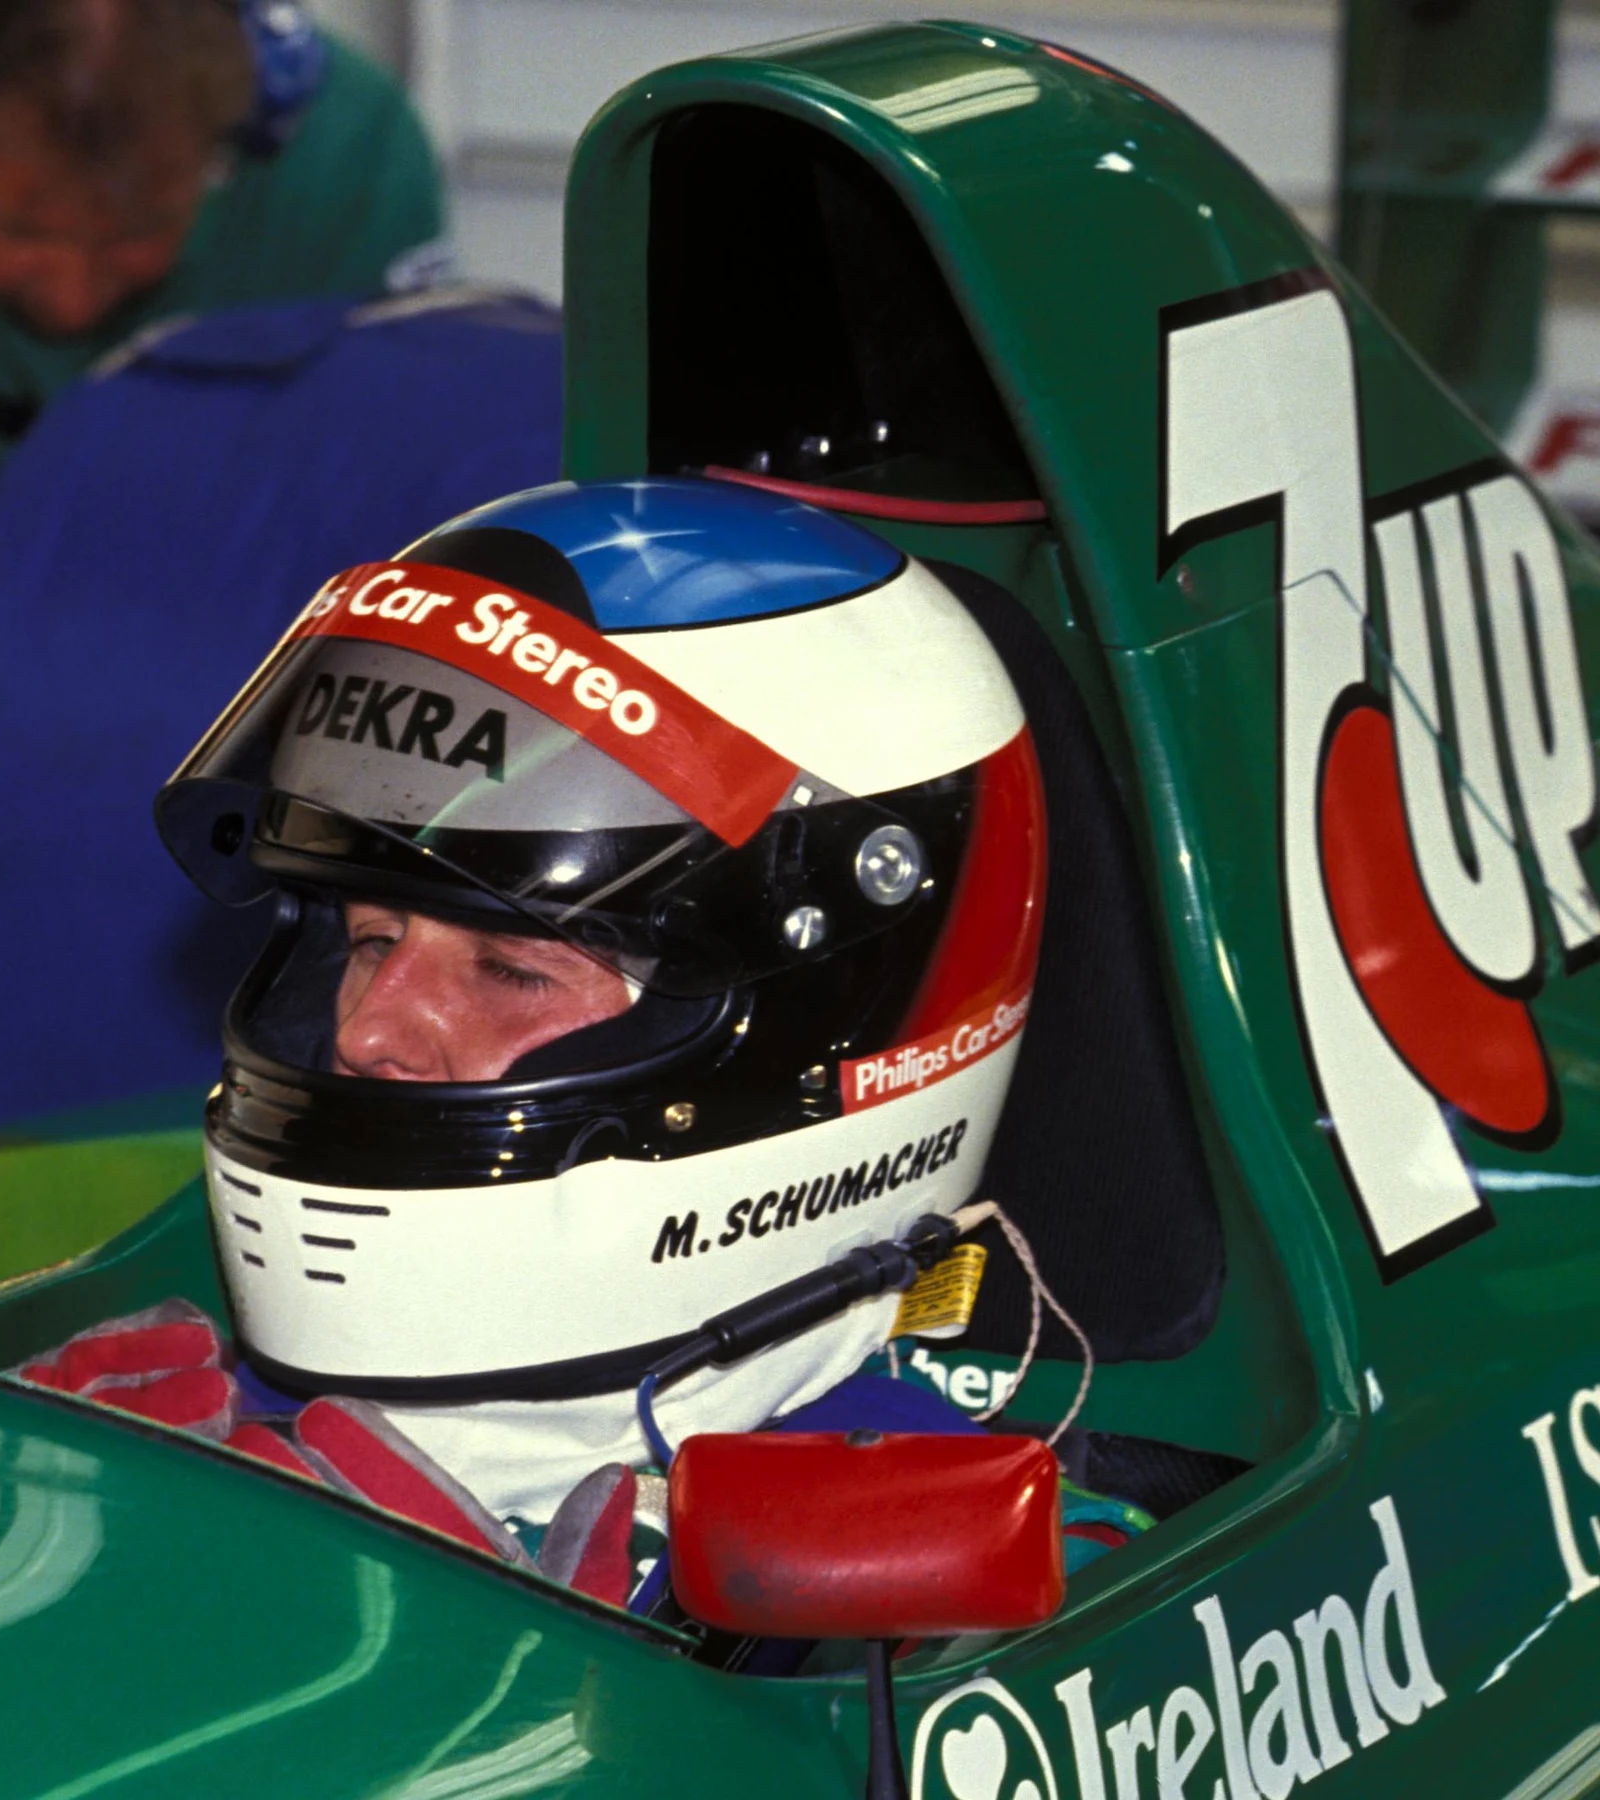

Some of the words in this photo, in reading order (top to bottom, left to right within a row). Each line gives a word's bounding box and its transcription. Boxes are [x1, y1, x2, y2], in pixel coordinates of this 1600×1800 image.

[349, 569, 454, 624] Car
[455, 593, 657, 736] Stereo
[297, 673, 507, 783] DEKRA
[856, 1047, 948, 1101] Philips
[952, 1024, 992, 1062] Car
[718, 1117, 968, 1249] SCHUMACHER
[1055, 1495, 1448, 1800] Ireland
